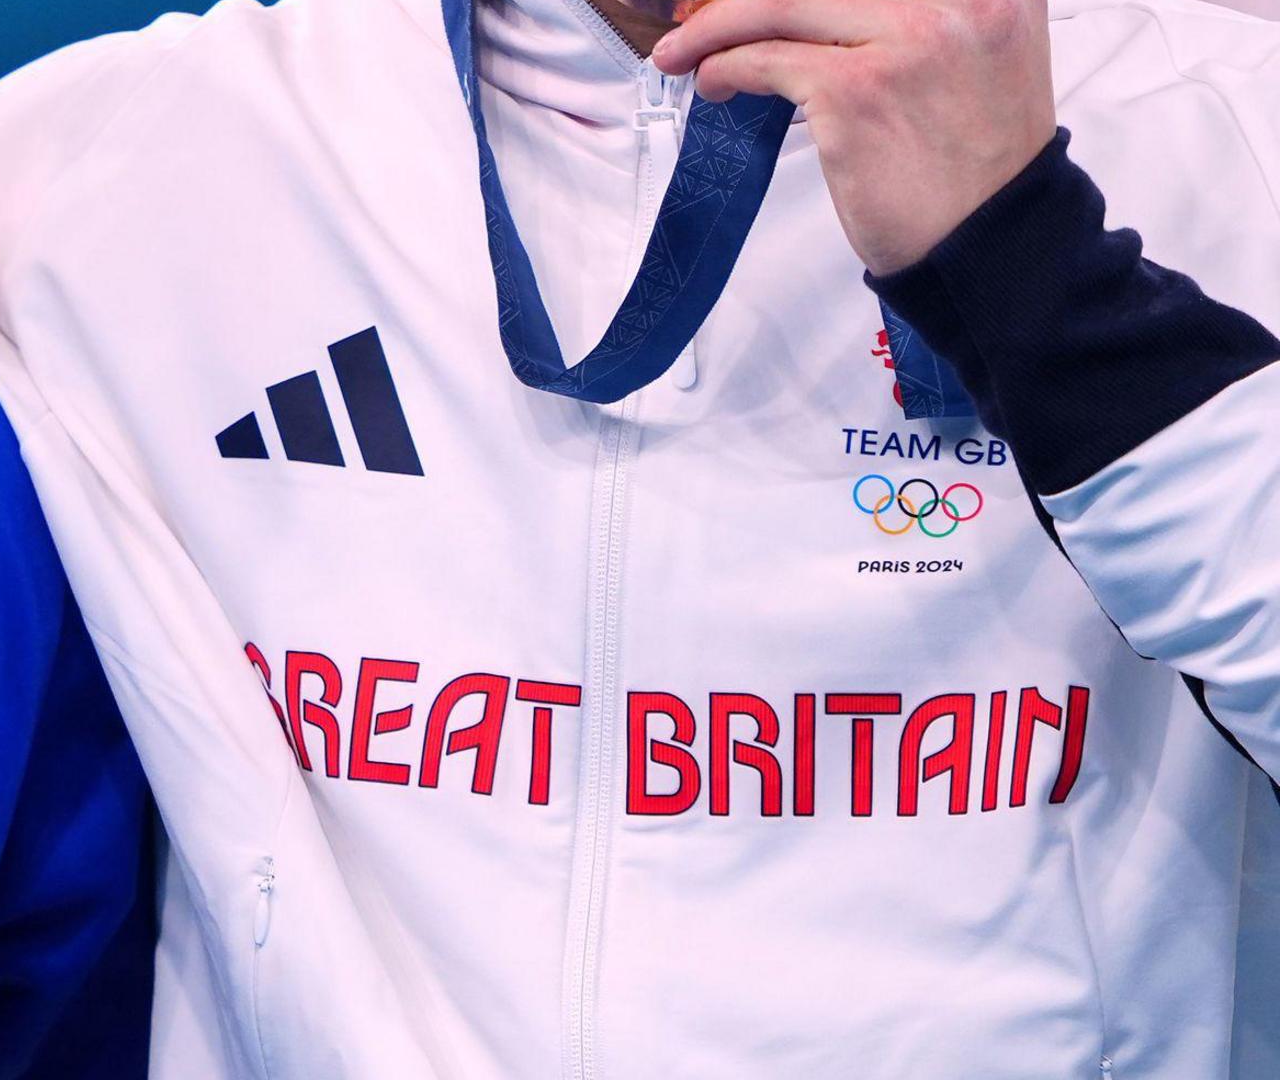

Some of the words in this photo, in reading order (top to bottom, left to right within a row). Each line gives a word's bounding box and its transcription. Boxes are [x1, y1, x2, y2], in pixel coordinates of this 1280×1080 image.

[842, 427, 942, 461] TEAM
[954, 437, 1008, 466] GB
[915, 559, 964, 573] 2024
[624, 683, 1091, 818] BRITAIN
